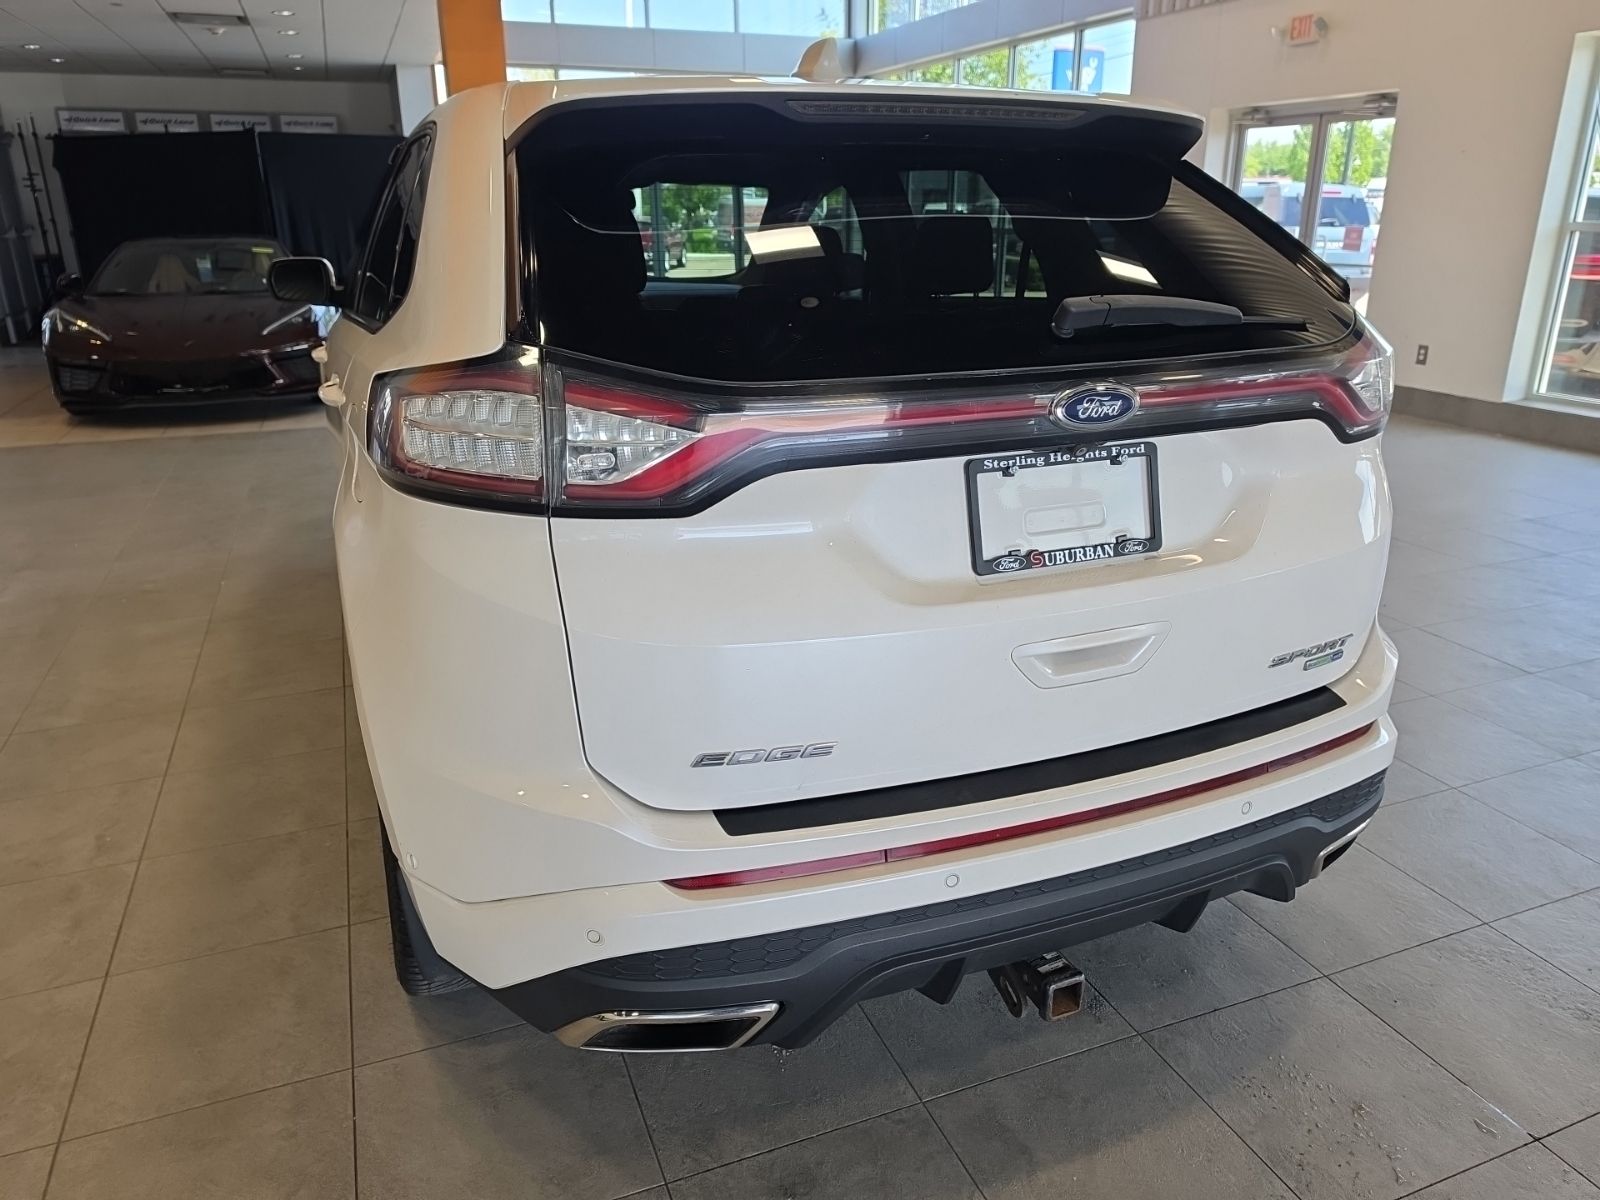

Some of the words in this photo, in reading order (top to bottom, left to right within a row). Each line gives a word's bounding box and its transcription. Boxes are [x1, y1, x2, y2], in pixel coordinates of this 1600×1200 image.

[1289, 14, 1314, 41] EXIT
[1077, 396, 1122, 418] Ford
[983, 455, 1046, 470] Sterling
[1049, 450, 1108, 463] Hehts
[1111, 444, 1145, 456] Ford
[1000, 557, 1020, 570] Ford
[1031, 544, 1114, 568] SUBURBAN
[1124, 541, 1143, 553] Ford
[1268, 633, 1354, 668] SPORT
[690, 741, 839, 768] EDGE
